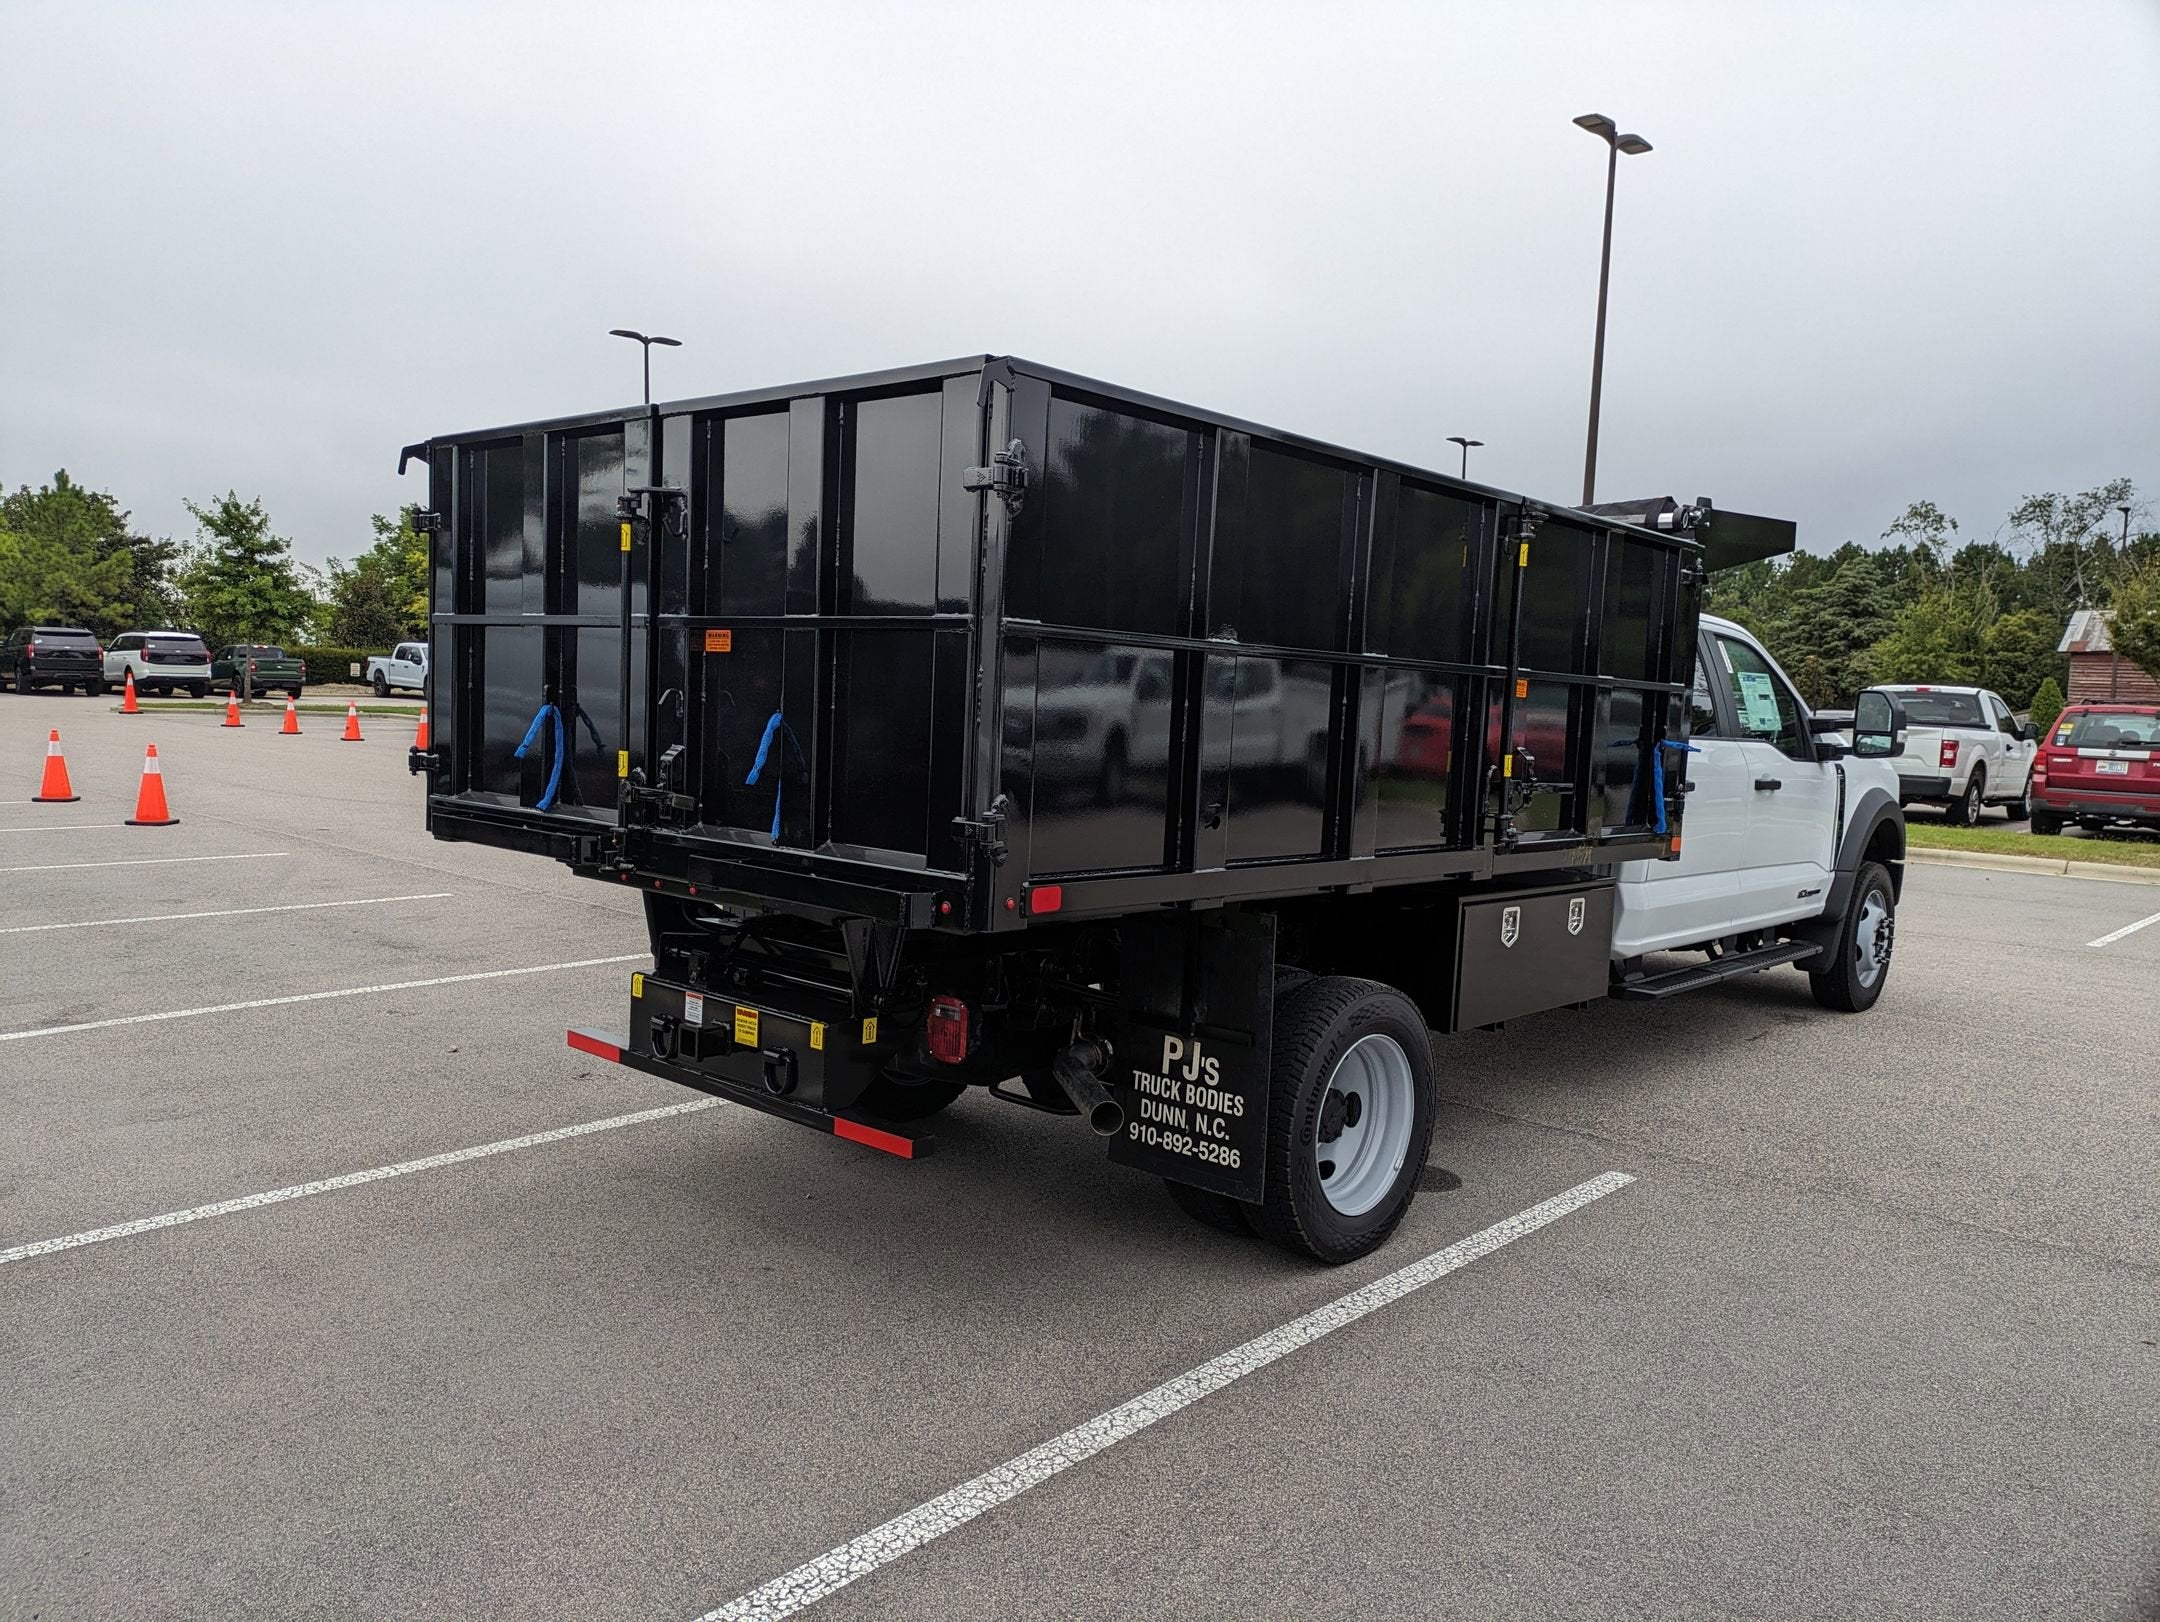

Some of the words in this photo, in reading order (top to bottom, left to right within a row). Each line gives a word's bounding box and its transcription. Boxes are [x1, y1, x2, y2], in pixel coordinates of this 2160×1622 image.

[1132, 1069, 1181, 1102] TRUCK
[1185, 1083, 1244, 1117] BODIES
[1300, 1039, 1340, 1147] Continental
[1140, 1098, 1190, 1134] DUNN,
[1195, 1112, 1230, 1141] N.C.
[1129, 1121, 1241, 1169] 910-892-5286
